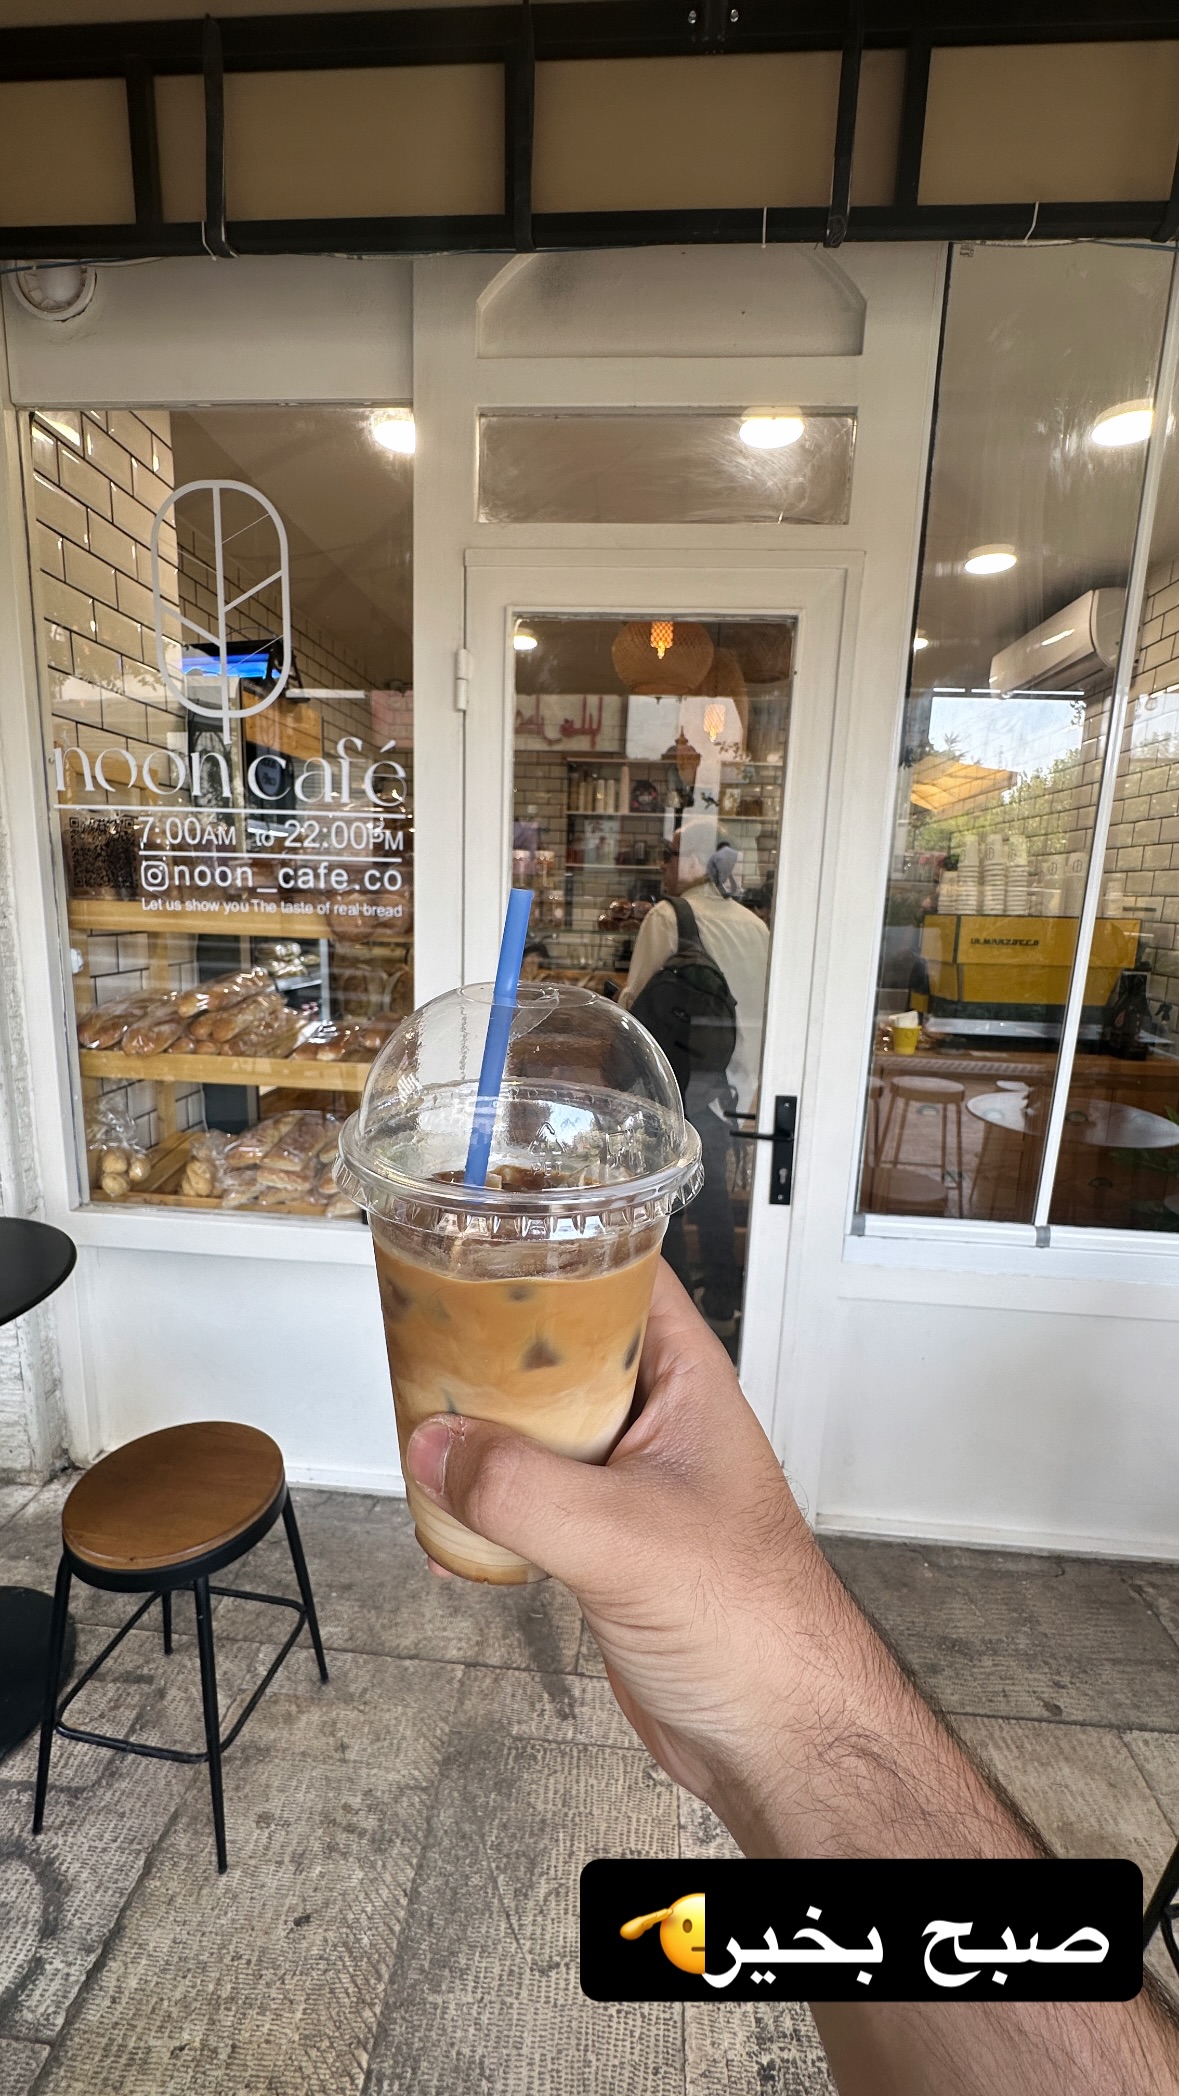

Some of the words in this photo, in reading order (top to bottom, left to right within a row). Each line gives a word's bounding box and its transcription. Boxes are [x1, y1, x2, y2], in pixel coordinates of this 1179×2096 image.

[53, 746, 232, 798] noon
[248, 736, 407, 807] café
[255, 829, 275, 847] to
[173, 862, 402, 893] noon_cafe.co
[141, 897, 163, 911] Let
[165, 899, 182, 911] us
[185, 898, 220, 912] show
[222, 899, 249, 915] you
[250, 898, 277, 913] The
[280, 900, 313, 914] taste
[316, 901, 331, 915] of
[333, 902, 360, 916] real
[362, 903, 402, 917] bread
